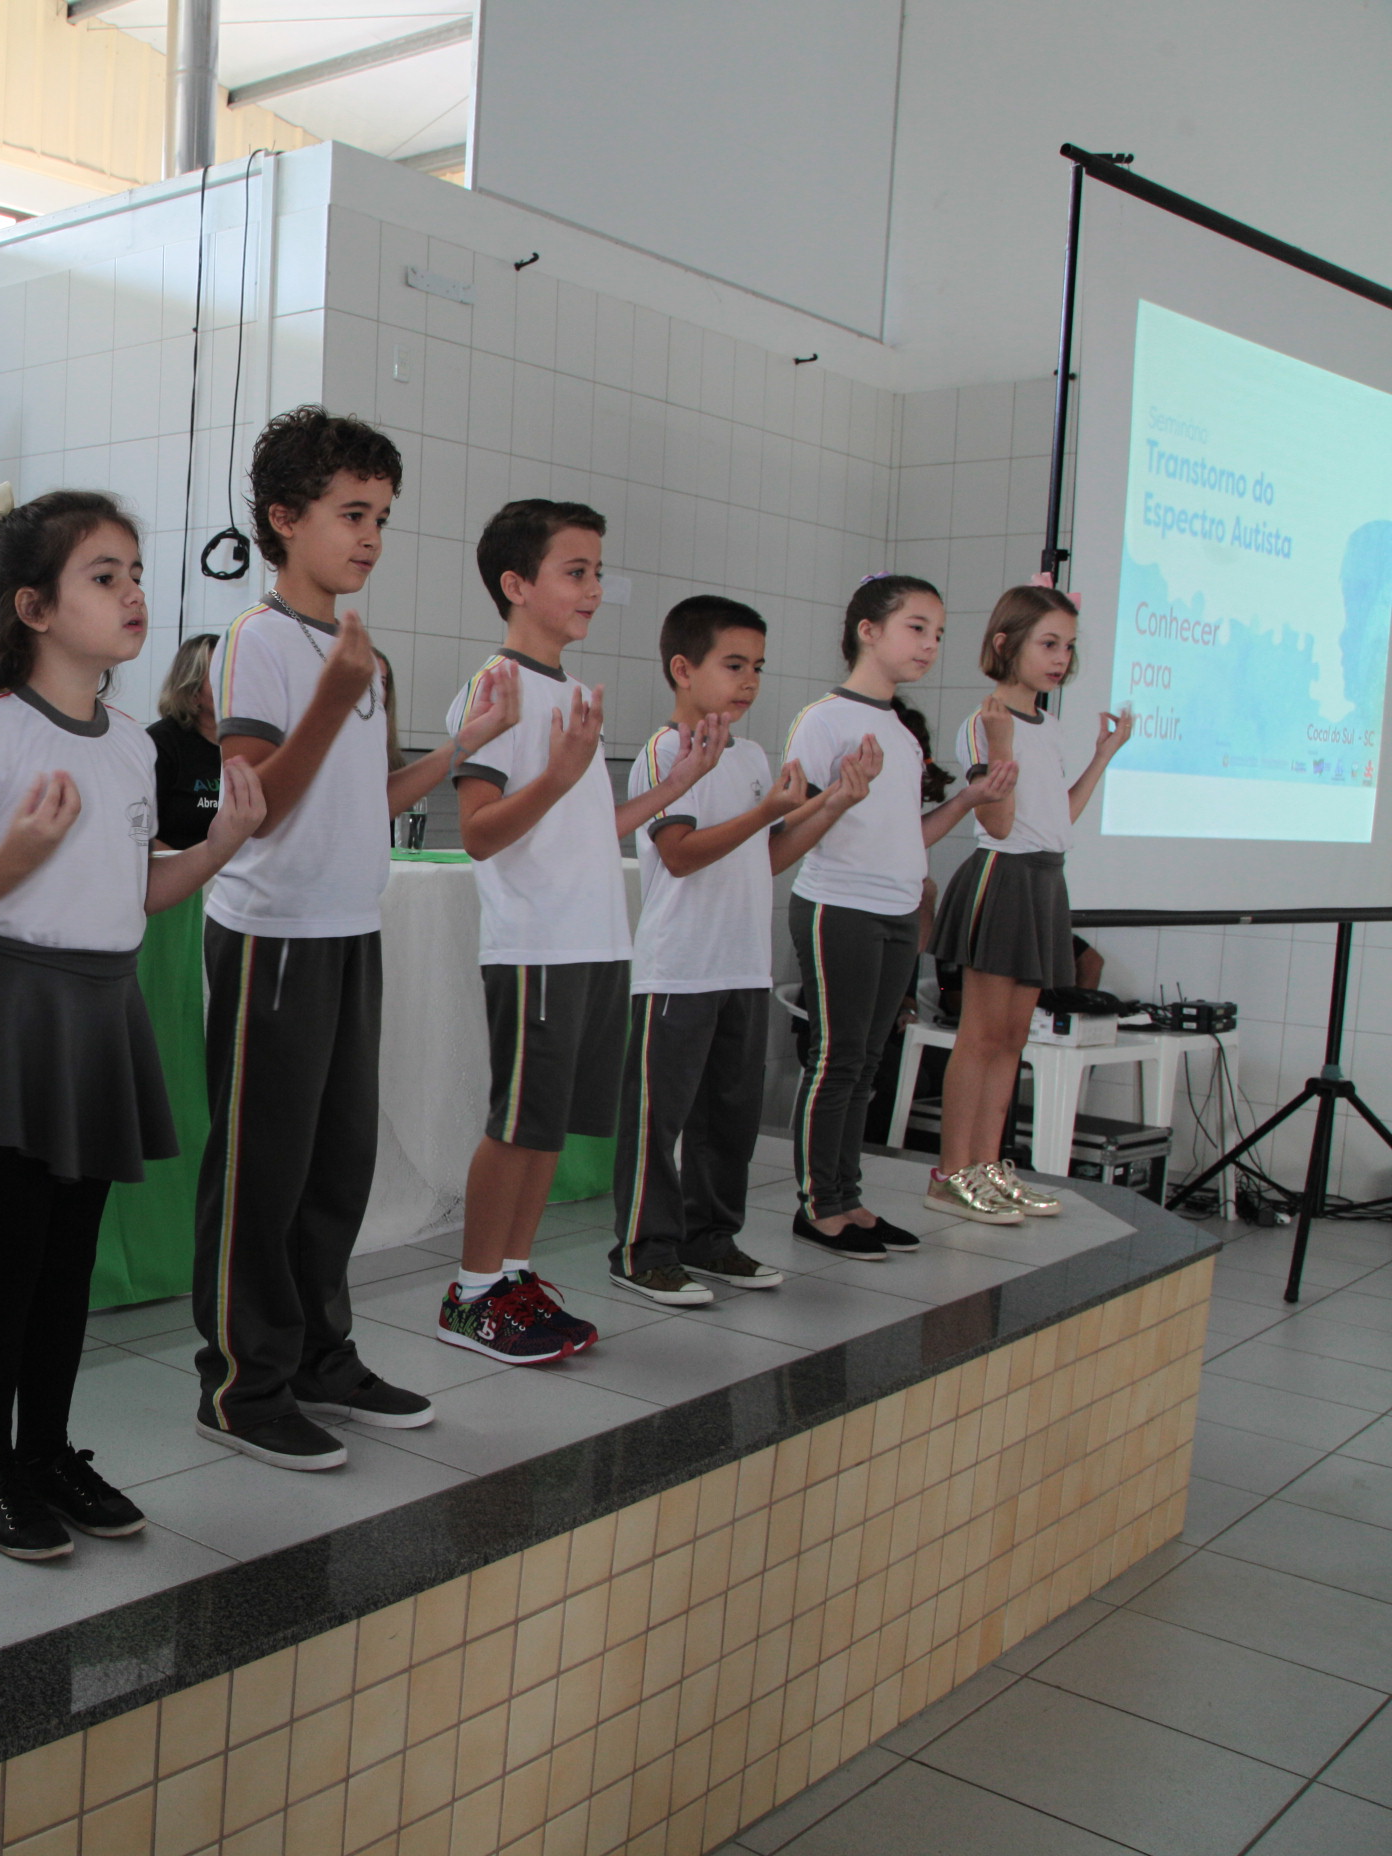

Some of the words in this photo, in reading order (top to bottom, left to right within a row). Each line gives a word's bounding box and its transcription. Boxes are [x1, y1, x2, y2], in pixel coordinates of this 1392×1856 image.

[1146, 438, 1248, 499] Transtorno
[1252, 471, 1275, 506] do
[1143, 491, 1226, 544] Espectro
[1230, 515, 1293, 560] Autista
[1135, 601, 1221, 646] Conhecer
[1130, 661, 1172, 695] para
[1132, 706, 1182, 741] ncluir.
[1307, 724, 1330, 742] Cocal
[1331, 727, 1341, 744] do
[1342, 727, 1355, 745] Sul
[1363, 730, 1375, 747] SC
